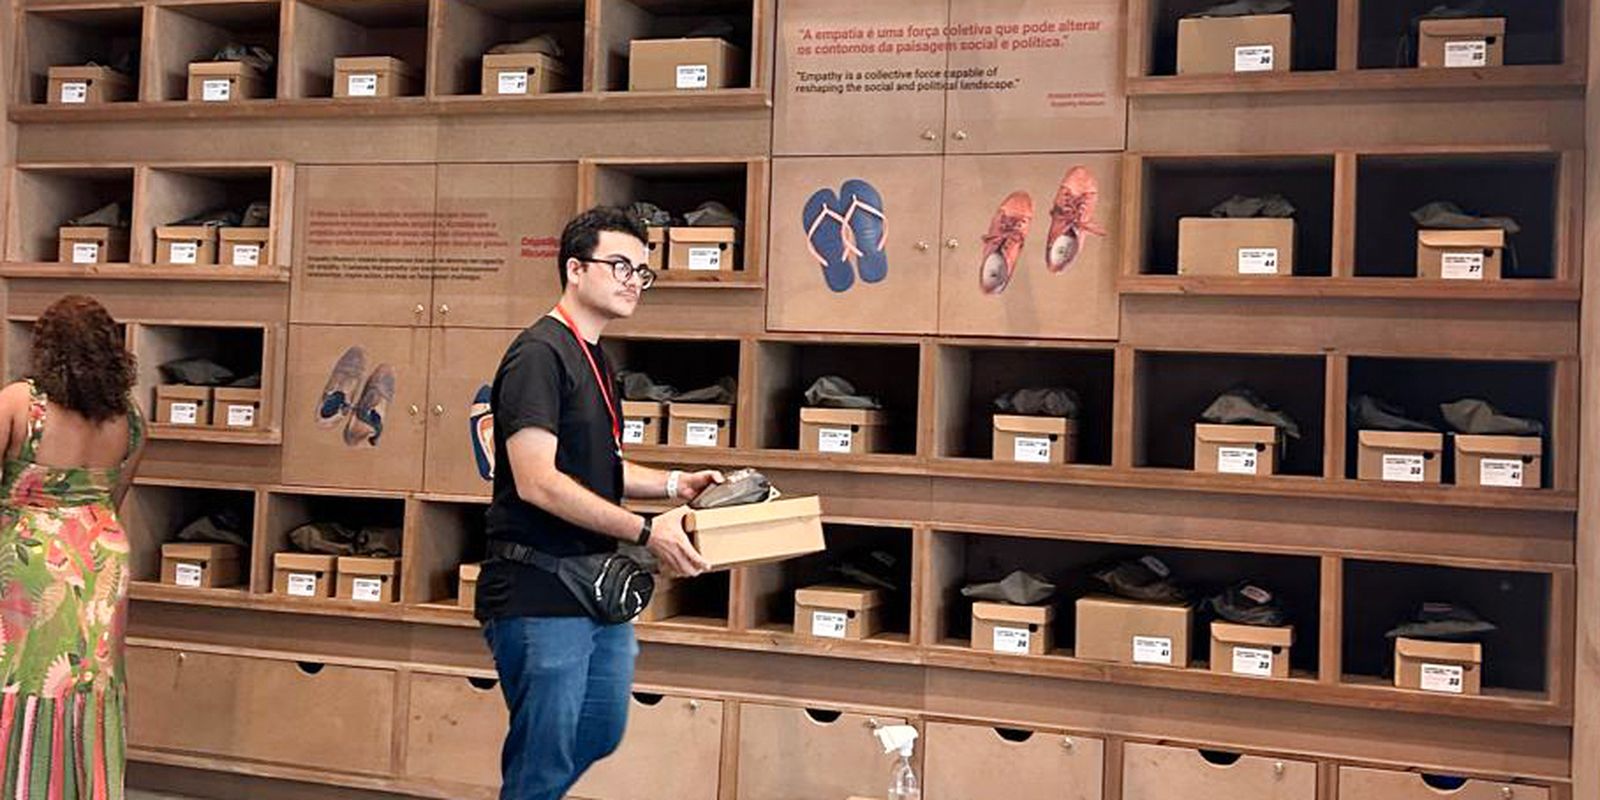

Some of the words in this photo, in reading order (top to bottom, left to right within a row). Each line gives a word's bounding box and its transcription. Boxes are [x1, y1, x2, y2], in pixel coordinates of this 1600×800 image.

[814, 27, 864, 41] empatia
[866, 27, 875, 38] é
[877, 28, 904, 38] uma
[907, 25, 939, 38] força
[942, 23, 992, 36] coletiva
[995, 24, 1019, 36] que
[1022, 21, 1056, 35] pode
[1058, 20, 1101, 32] alterar
[797, 46, 812, 55] os
[815, 43, 875, 54] contornos
[878, 41, 893, 52] da
[896, 41, 958, 55] paisagem
[960, 38, 997, 50] social
[1000, 40, 1009, 50] e
[845, 71, 853, 80] is
[855, 72, 862, 80] a
[864, 69, 912, 80] collective
[914, 68, 941, 78] force
[944, 67, 985, 78] capable
[986, 66, 998, 76] of
[795, 83, 844, 94] reshaping
[846, 83, 862, 92] the
[864, 82, 894, 92] social
[896, 81, 915, 91] and
[917, 80, 958, 91] political
